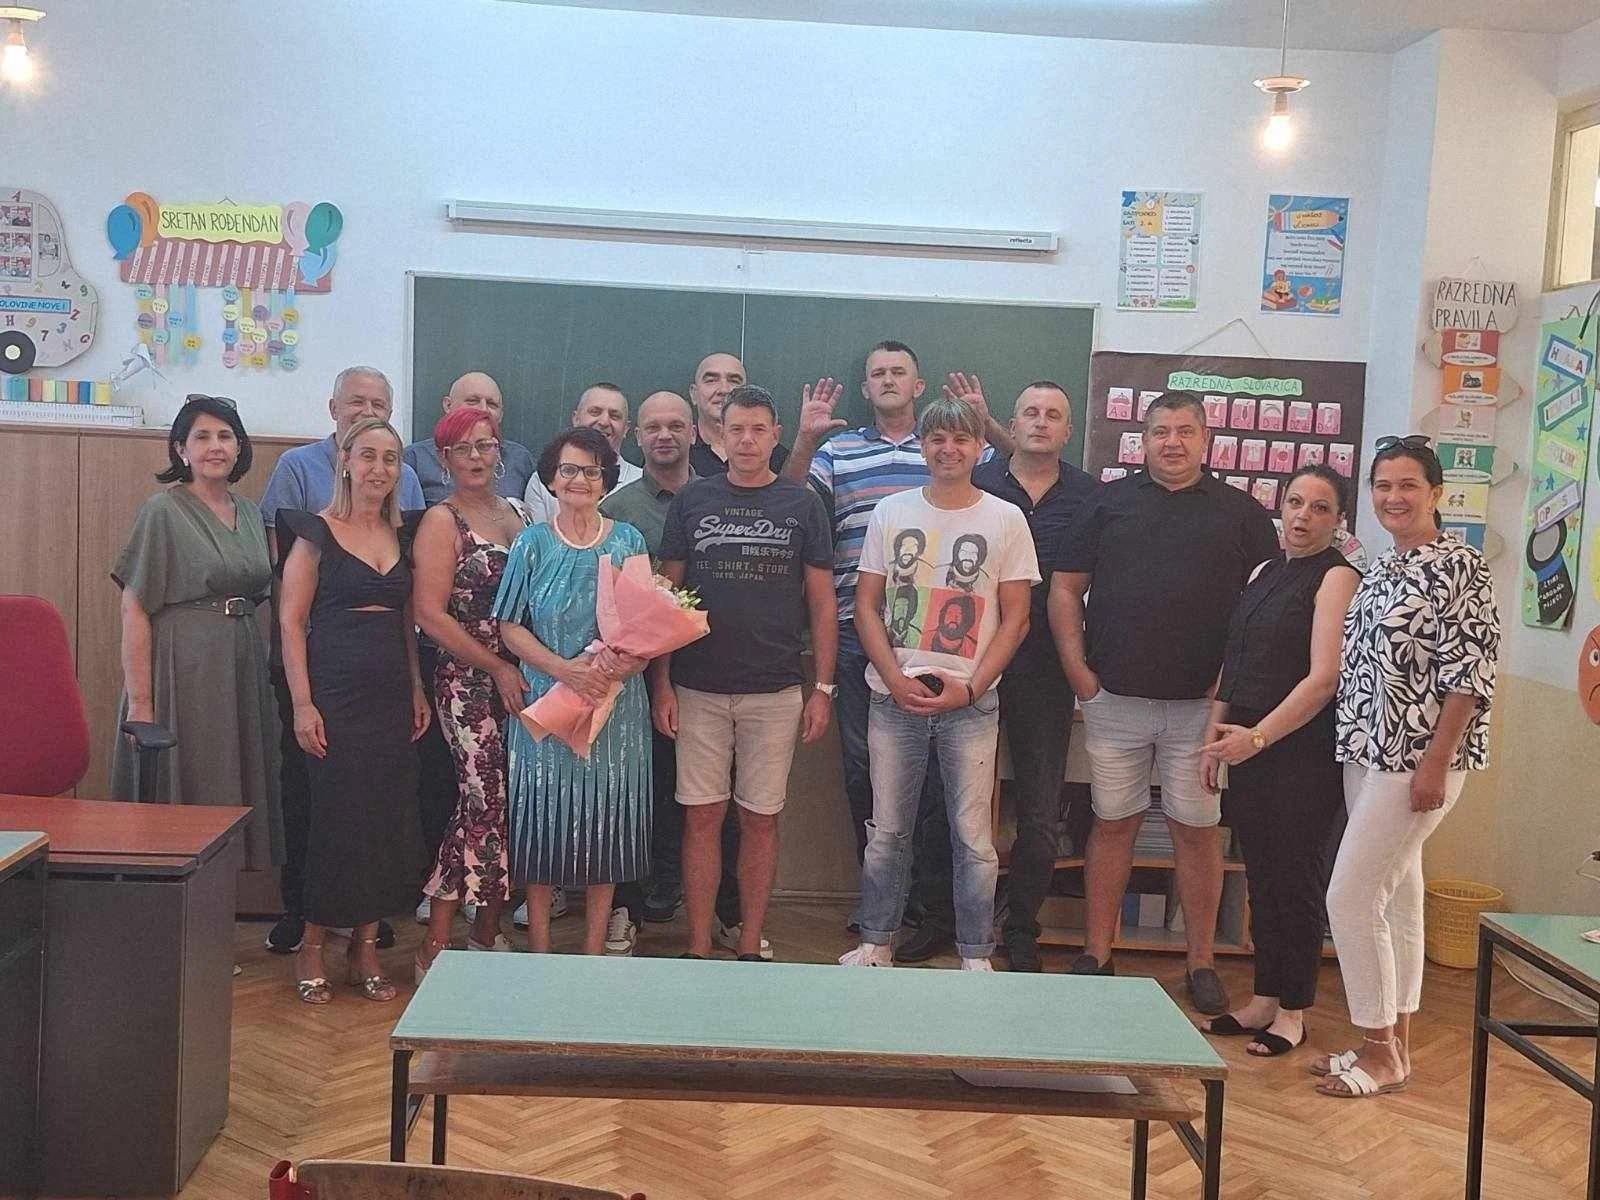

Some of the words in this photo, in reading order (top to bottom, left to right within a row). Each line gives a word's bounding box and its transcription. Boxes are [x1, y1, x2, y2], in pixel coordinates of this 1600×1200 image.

[161, 211, 207, 231] SRETAN
[210, 212, 279, 233] ROĐENDAN
[1437, 281, 1517, 306] RAZREDNA
[1435, 308, 1498, 330] PRAVILA
[1169, 375, 1233, 391] RAZREDNA
[724, 507, 764, 518] VINTAGE
[758, 563, 791, 575] STORE
